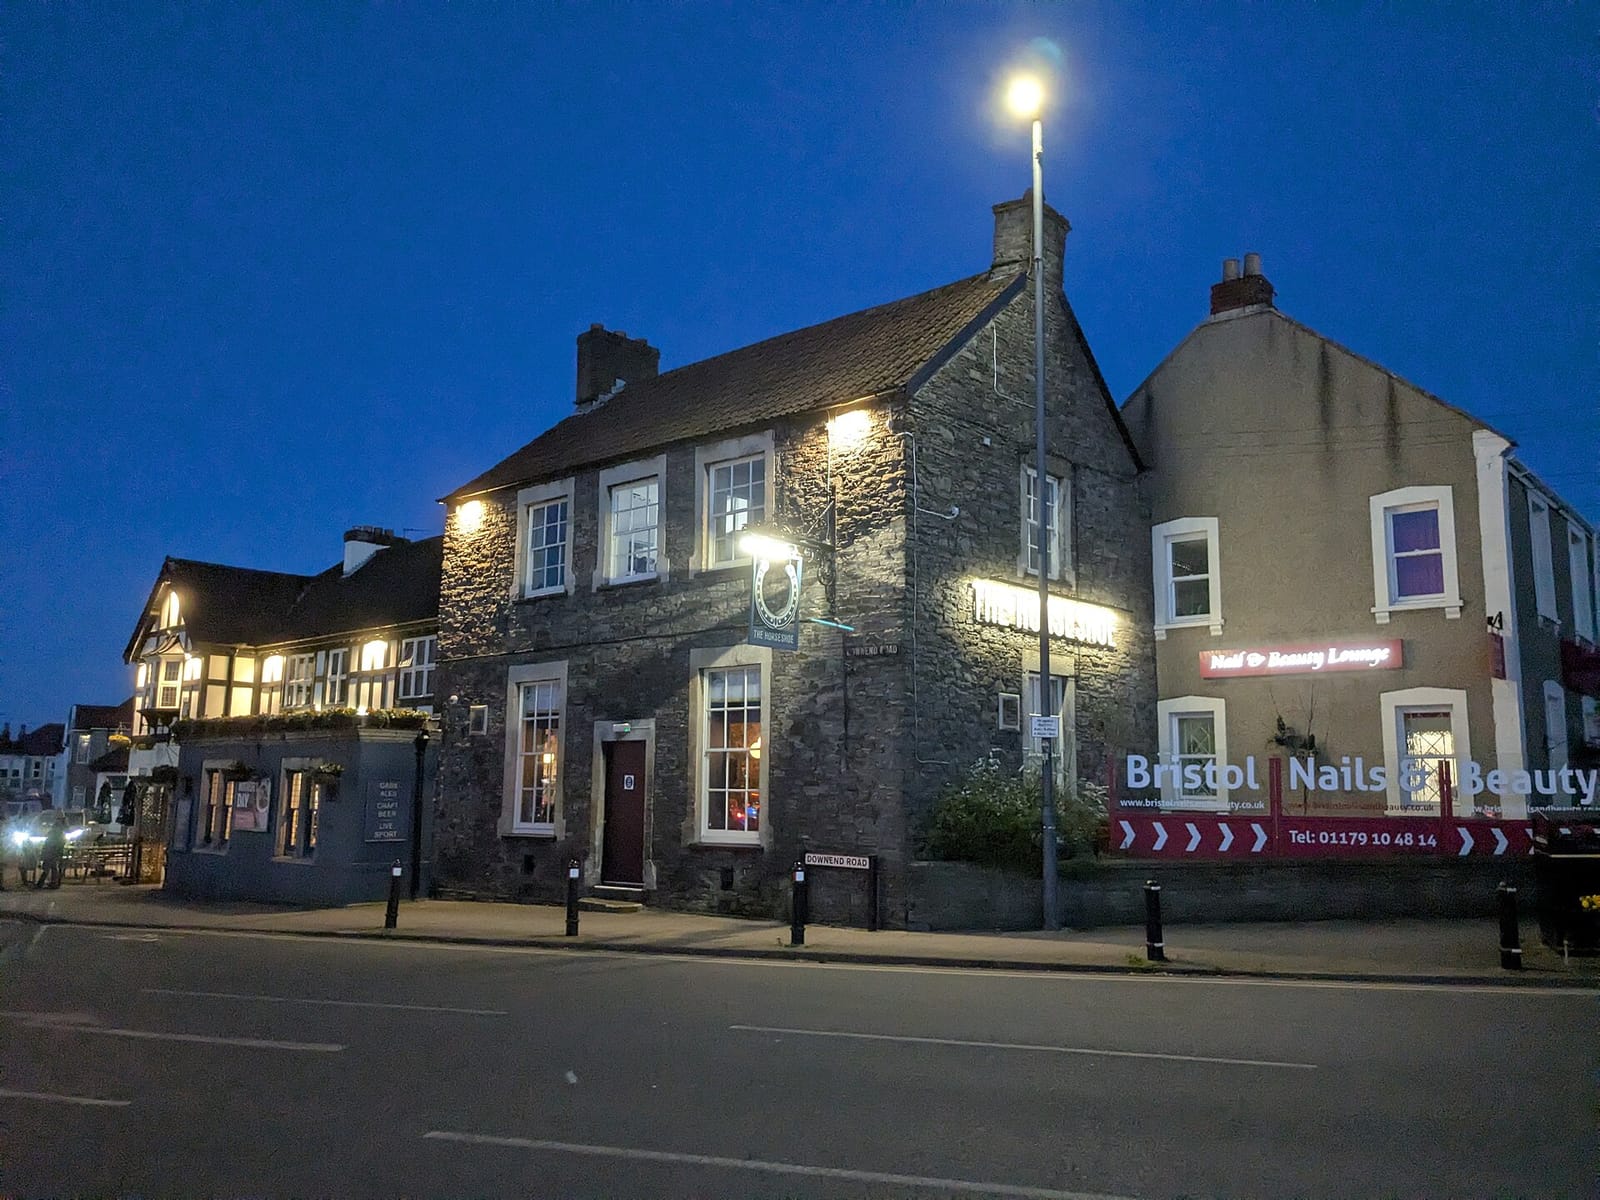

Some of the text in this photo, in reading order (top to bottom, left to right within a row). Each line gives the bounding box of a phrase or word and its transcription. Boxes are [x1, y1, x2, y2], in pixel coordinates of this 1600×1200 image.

[753, 629, 794, 644] THE HORSESHOE
[1210, 647, 1390, 670] Nail & Beauty Lounge
[1127, 754, 1598, 805] Bristol Nails & Beauty
[373, 830, 398, 839] SPORT
[1289, 830, 1438, 847] Tel: 01179 10 48 14
[807, 855, 868, 867] DOWNEND ROAD
